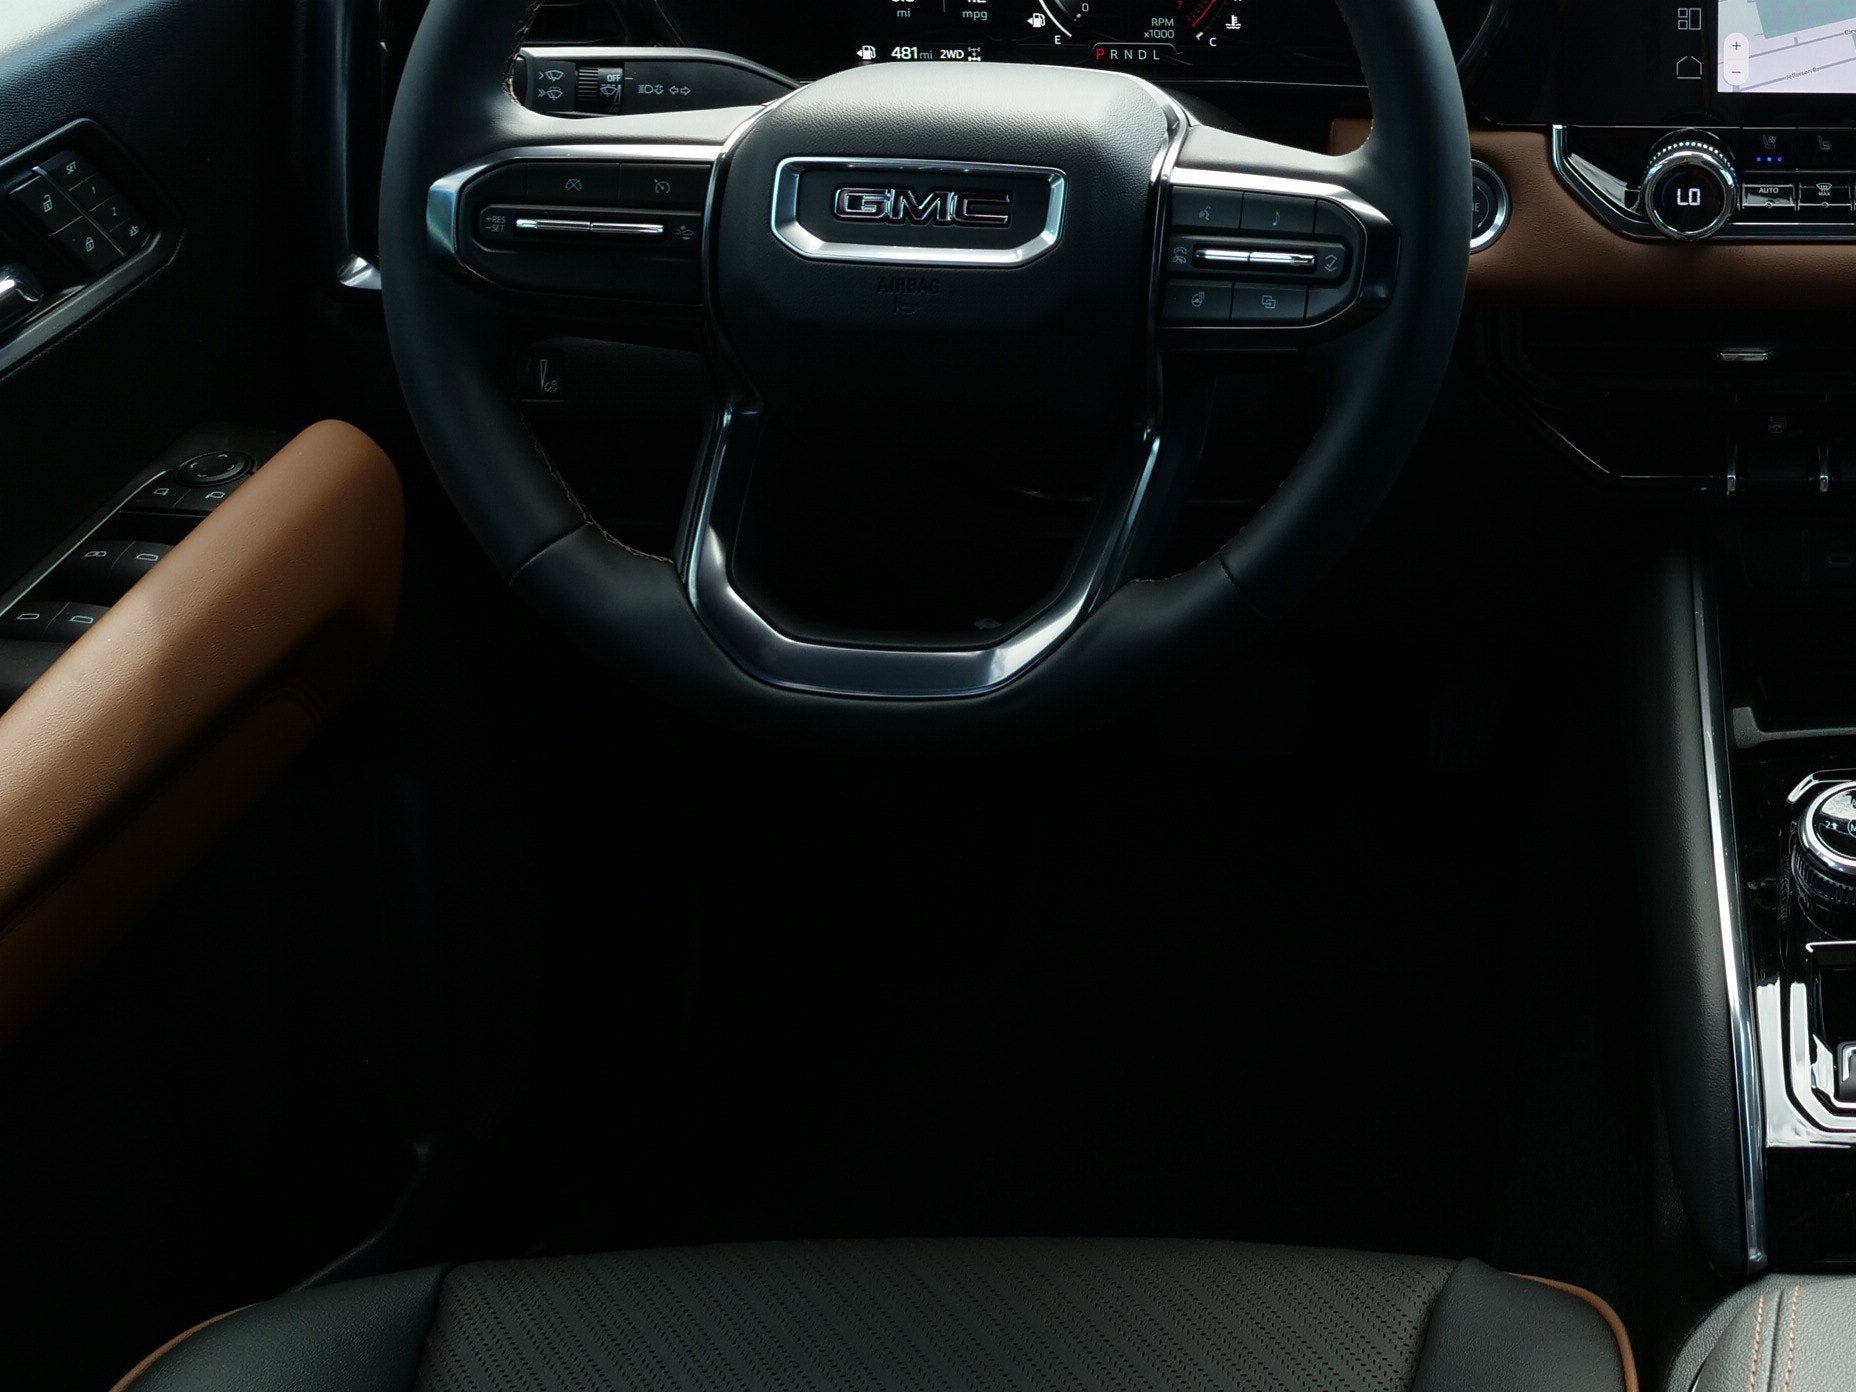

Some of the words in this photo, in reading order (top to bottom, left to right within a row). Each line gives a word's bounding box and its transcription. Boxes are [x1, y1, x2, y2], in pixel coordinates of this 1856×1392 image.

[896, 7, 911, 18] mi
[962, 10, 988, 21] mpg
[1151, 17, 1175, 27] RPM
[1143, 29, 1175, 39] x1000
[1054, 35, 1061, 45] E
[1209, 37, 1217, 47] C
[891, 46, 918, 60] 481
[919, 50, 933, 60] mi
[939, 49, 965, 59] 2WD
[1095, 49, 1105, 60] P
[1110, 50, 1119, 60] R
[1124, 50, 1134, 60] N
[1138, 50, 1147, 60] D
[1153, 50, 1160, 60] L
[606, 73, 621, 82] OFF
[835, 187, 1011, 225] GMC
